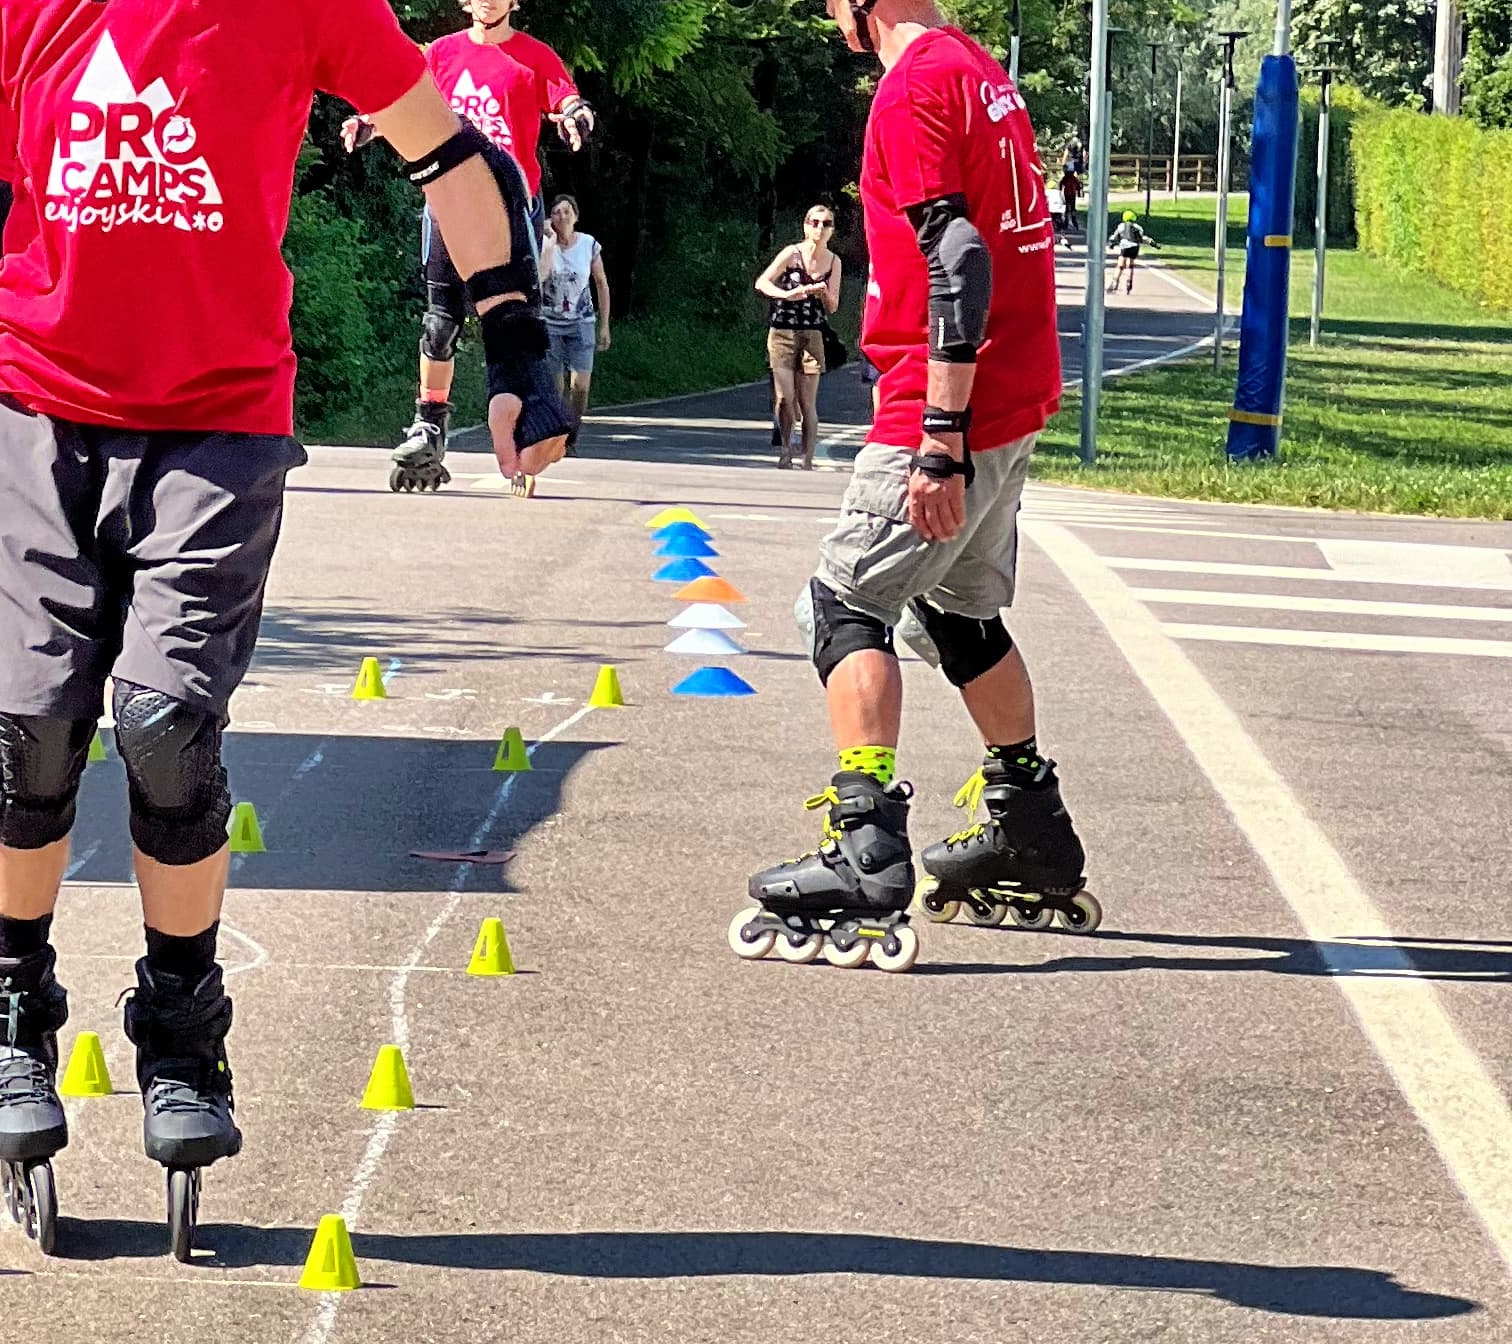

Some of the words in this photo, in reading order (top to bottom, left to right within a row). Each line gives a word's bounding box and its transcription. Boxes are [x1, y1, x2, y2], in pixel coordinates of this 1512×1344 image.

[452, 96, 500, 117] PRO
[59, 102, 198, 163] PRO
[61, 162, 207, 201] CAMPS
